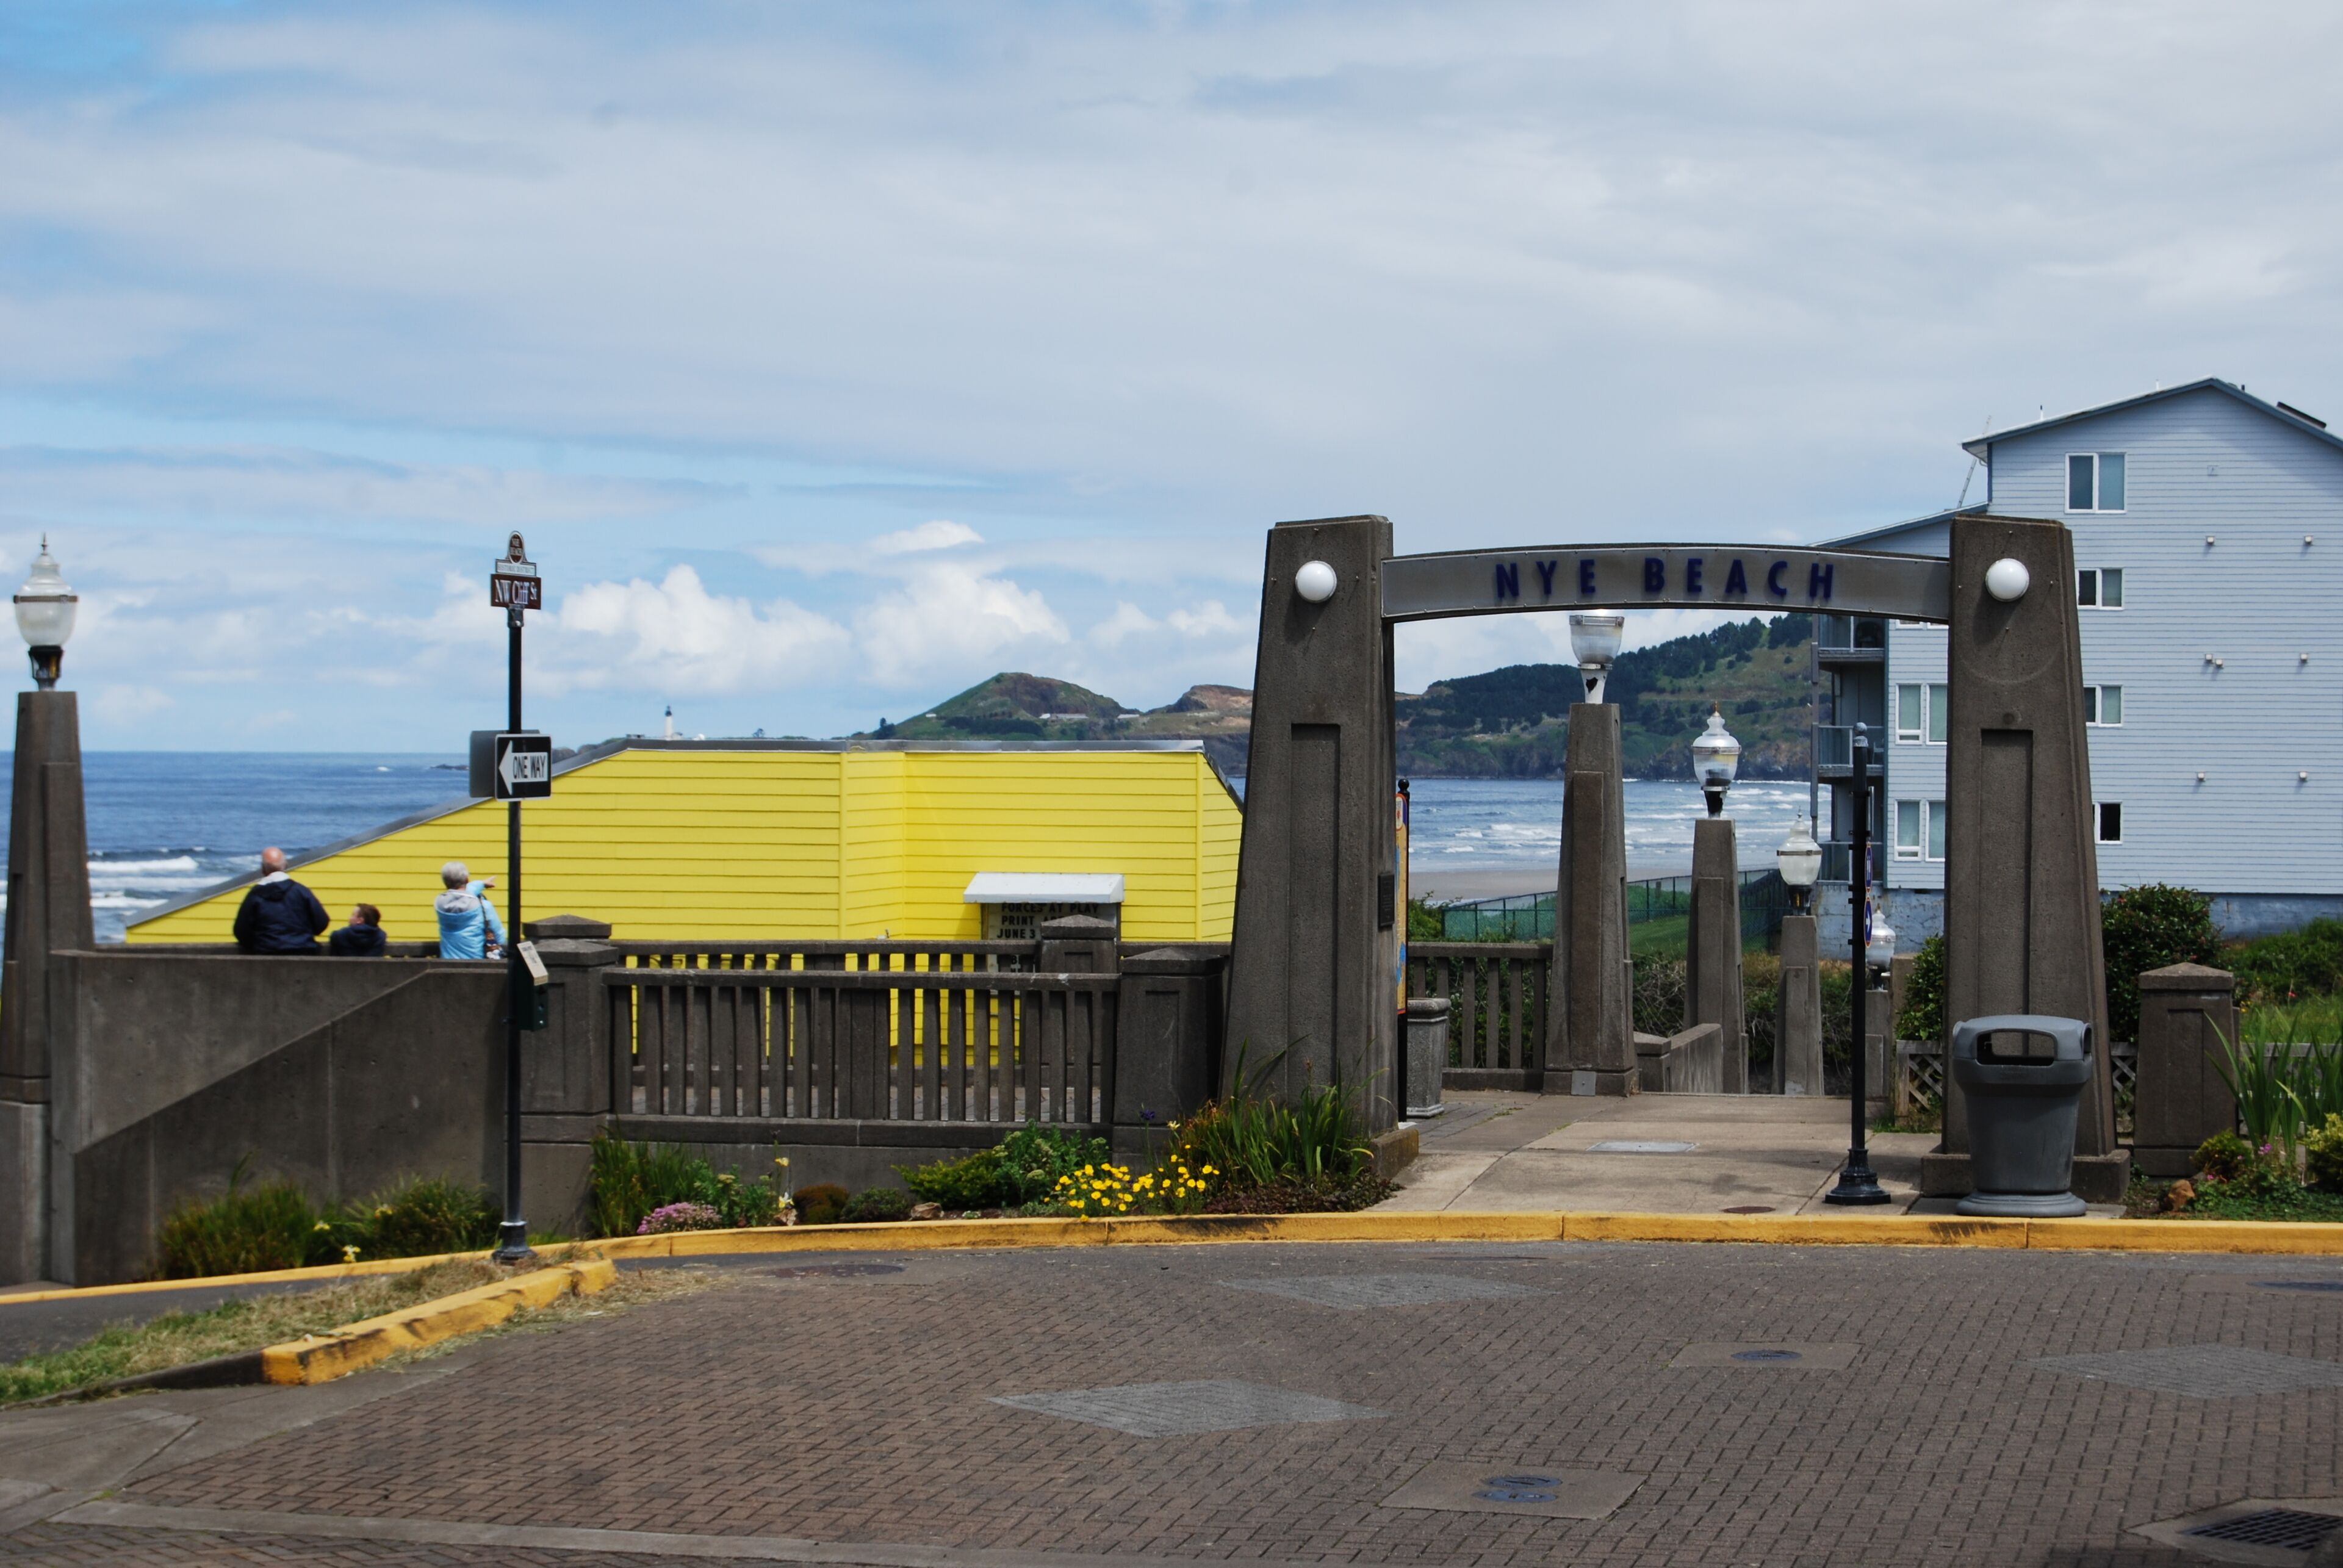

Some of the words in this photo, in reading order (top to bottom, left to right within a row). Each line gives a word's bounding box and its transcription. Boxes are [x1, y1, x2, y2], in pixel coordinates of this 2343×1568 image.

[1495, 558, 1596, 599] NYE
[1644, 557, 1834, 599] BEACH
[495, 579, 511, 603] NW
[513, 580, 530, 604] Cliff
[530, 581, 537, 600] St
[514, 756, 528, 779] ONE
[530, 756, 545, 779] WAY
[1001, 903, 1043, 913] FORCES
[1049, 904, 1064, 913] AT
[1070, 904, 1099, 913] PLAY
[1002, 916, 1034, 926] PRINT
[997, 929, 1026, 938] JUNE
